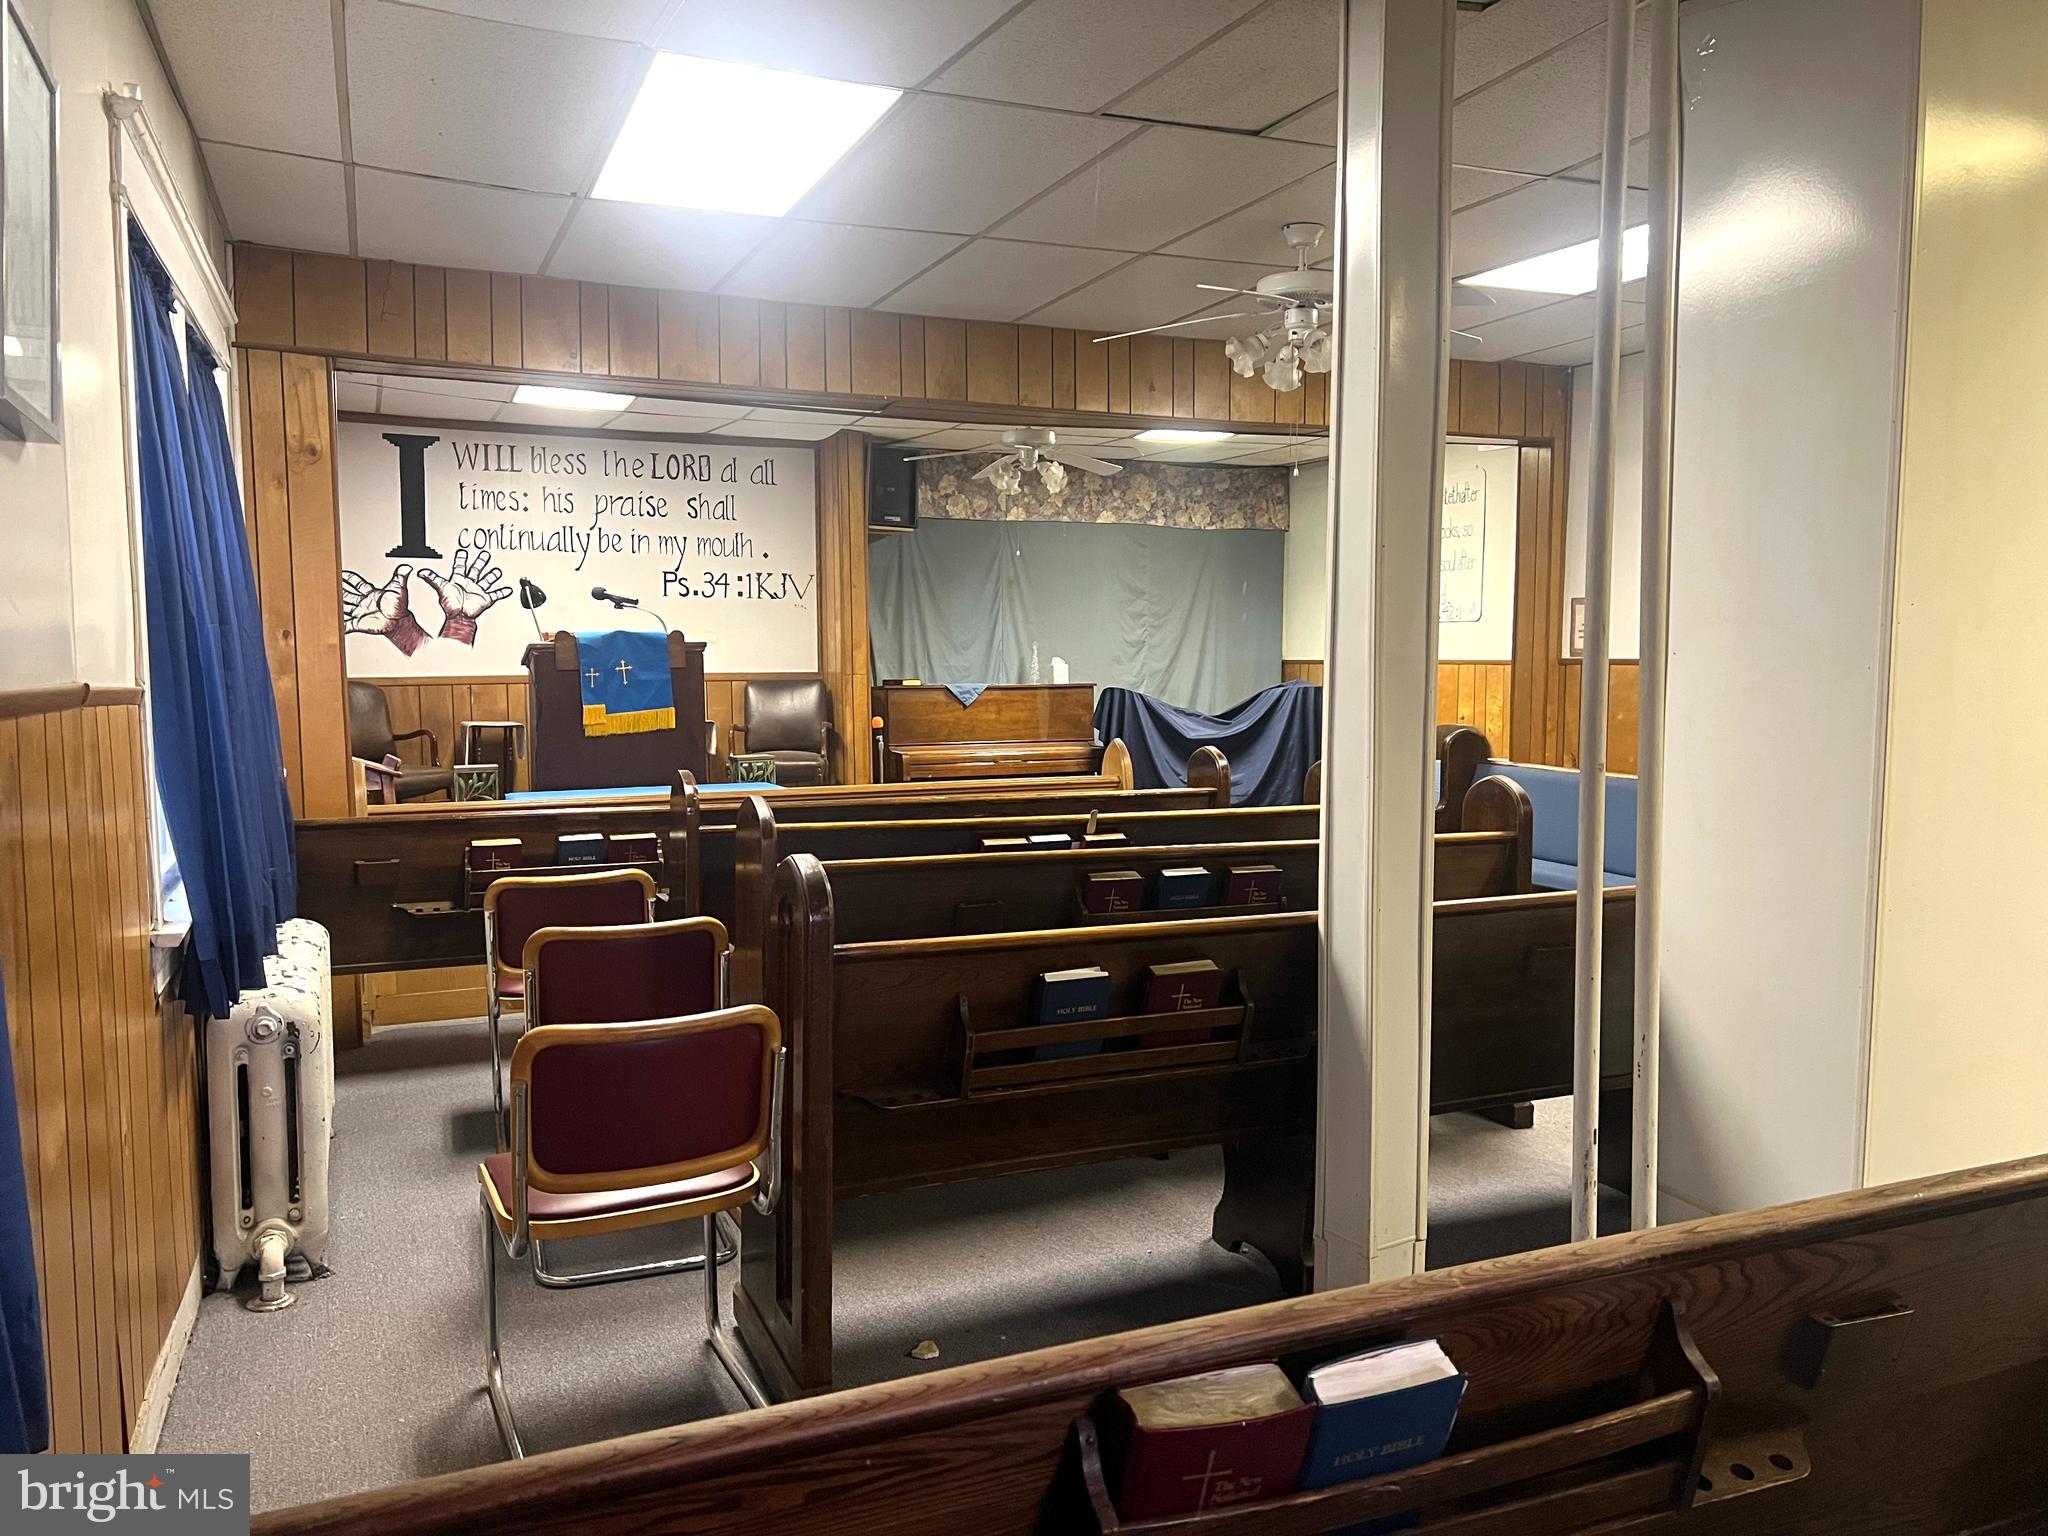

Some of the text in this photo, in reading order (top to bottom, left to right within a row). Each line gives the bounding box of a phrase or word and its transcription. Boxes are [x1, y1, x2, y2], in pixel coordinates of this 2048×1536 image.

[382, 433, 443, 559] I
[452, 441, 522, 472] WILL
[530, 445, 587, 475] bless
[603, 450, 644, 478] the
[651, 452, 711, 482] LORD
[750, 458, 778, 485] all
[458, 482, 737, 530] times: his praise shall
[458, 524, 590, 571] continually
[598, 527, 623, 553] be
[631, 528, 650, 554] in
[659, 535, 687, 572] my
[1056, 1004, 1097, 1016] HOLY BIBLE
[1334, 1436, 1425, 1467] HOLY BIBLE
